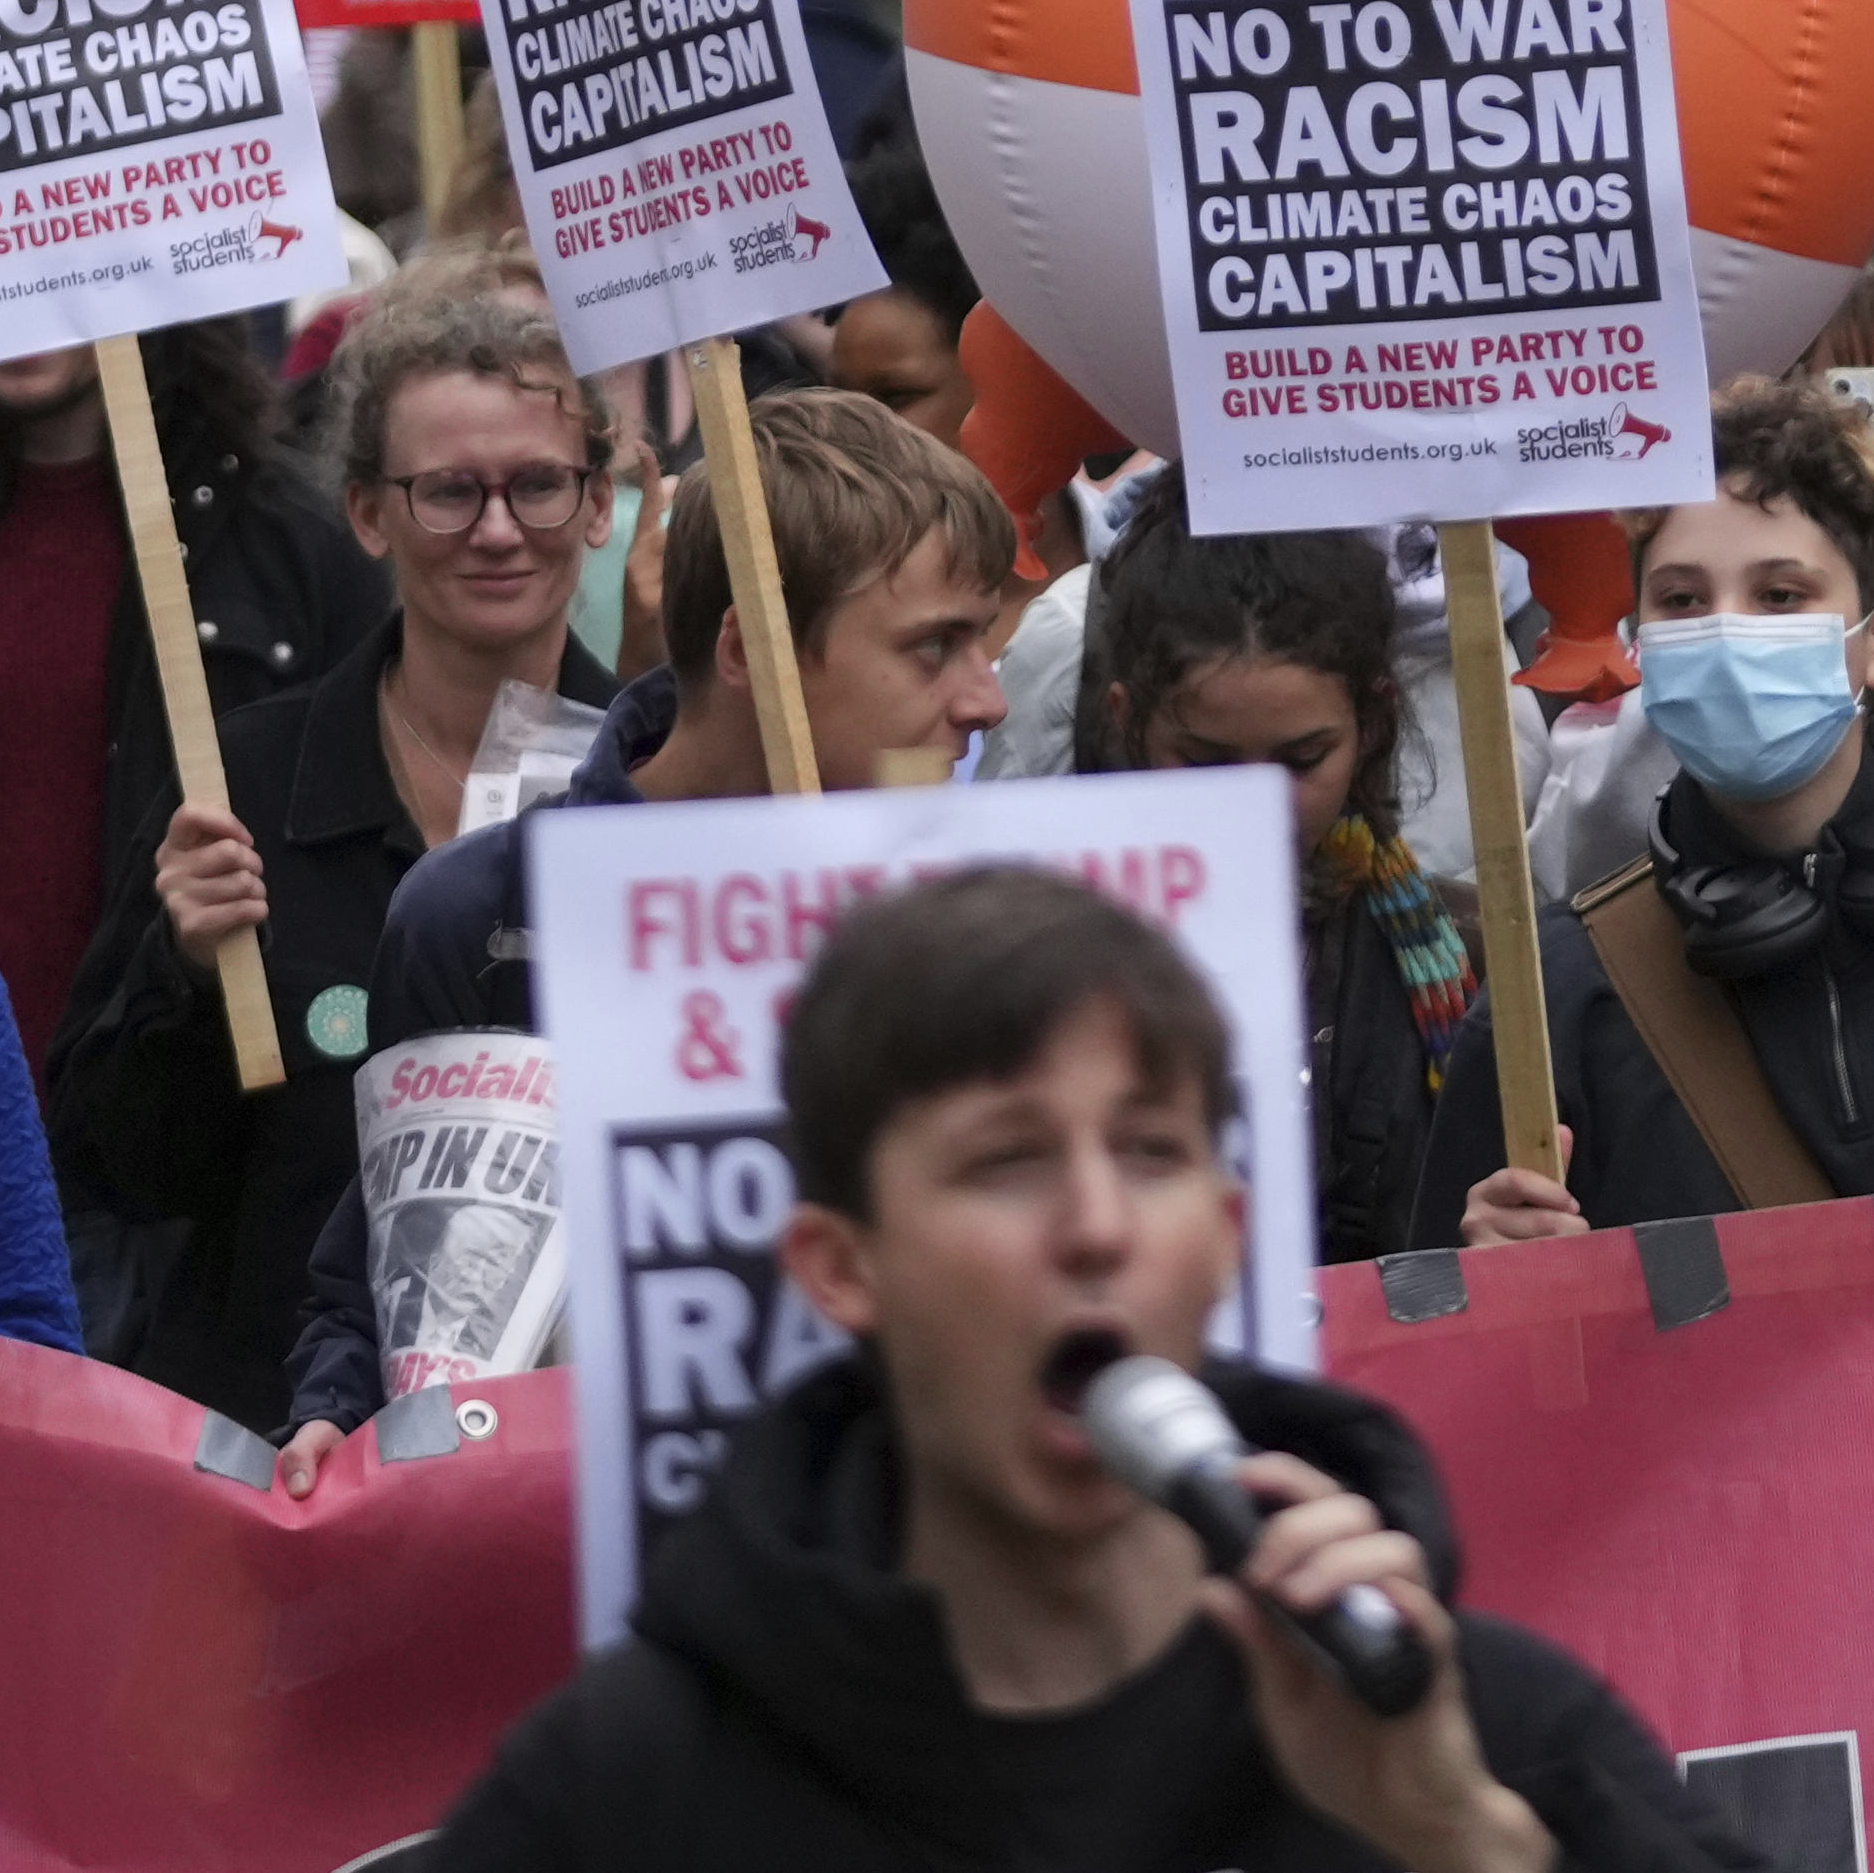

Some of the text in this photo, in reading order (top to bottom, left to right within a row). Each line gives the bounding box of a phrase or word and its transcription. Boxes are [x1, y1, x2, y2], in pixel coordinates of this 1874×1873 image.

[85, 4, 251, 74] CHAOS
[1226, 326, 1644, 380] BUILD A NEW PARTY TO
[1244, 438, 1497, 468] socialiststudents.org.uk
[675, 988, 744, 1081] &
[620, 1135, 797, 1260] NO
